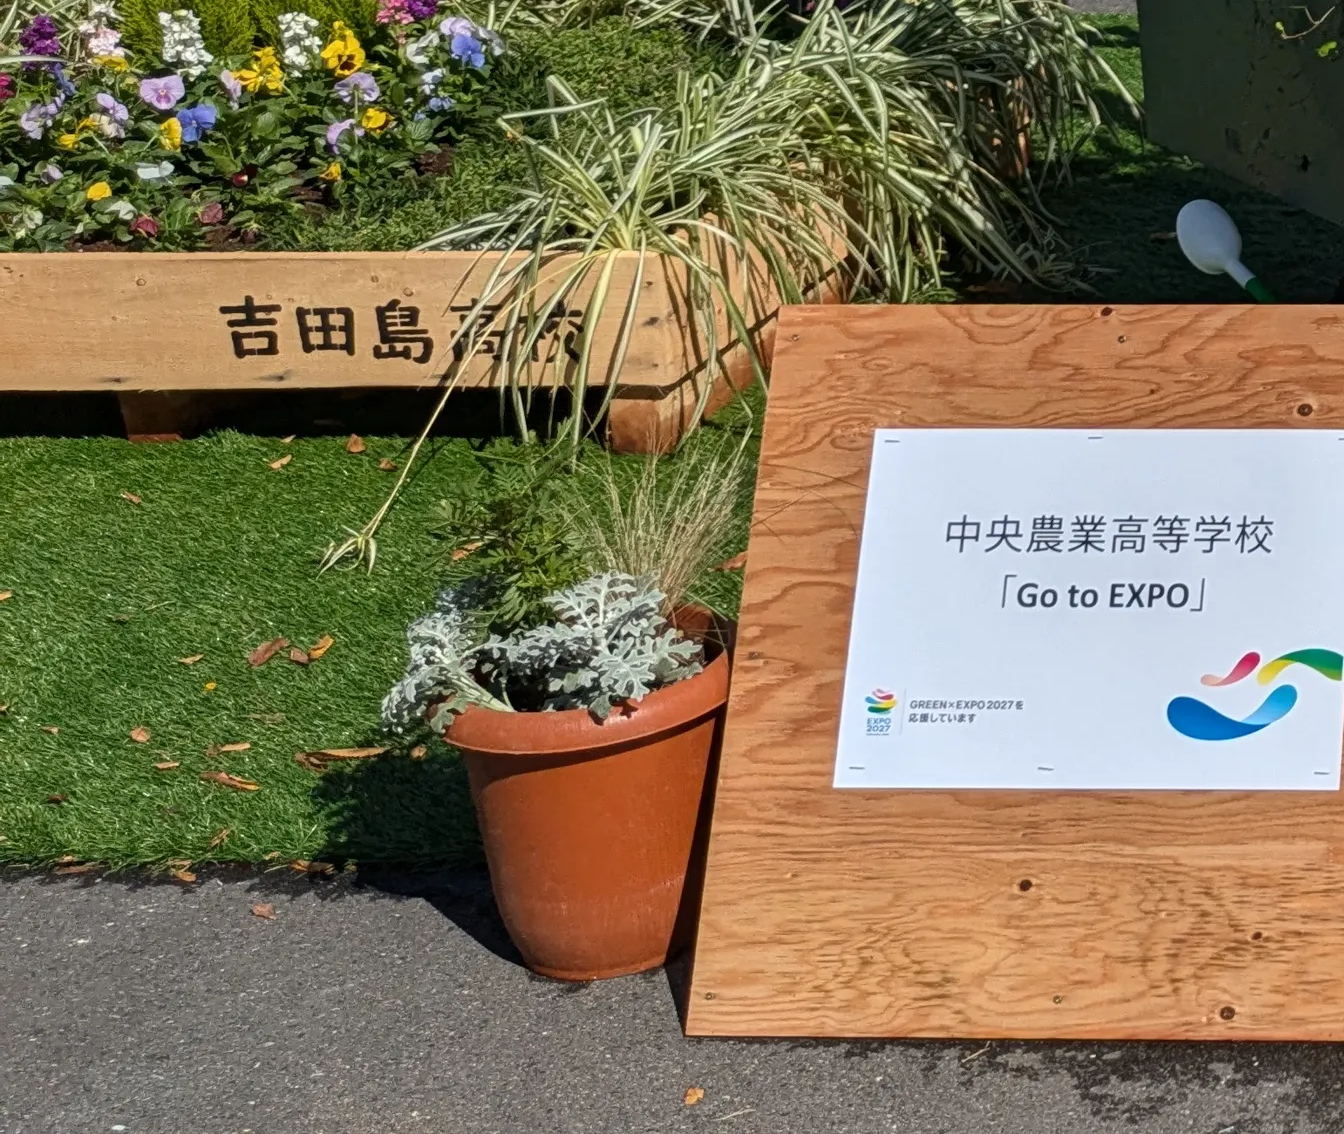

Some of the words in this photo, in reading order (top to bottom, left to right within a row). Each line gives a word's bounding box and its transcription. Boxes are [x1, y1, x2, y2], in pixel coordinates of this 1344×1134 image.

[944, 514, 1274, 555] 中央農業高等学校
[1068, 584, 1099, 609] to
[908, 713, 976, 723] 応援しています
